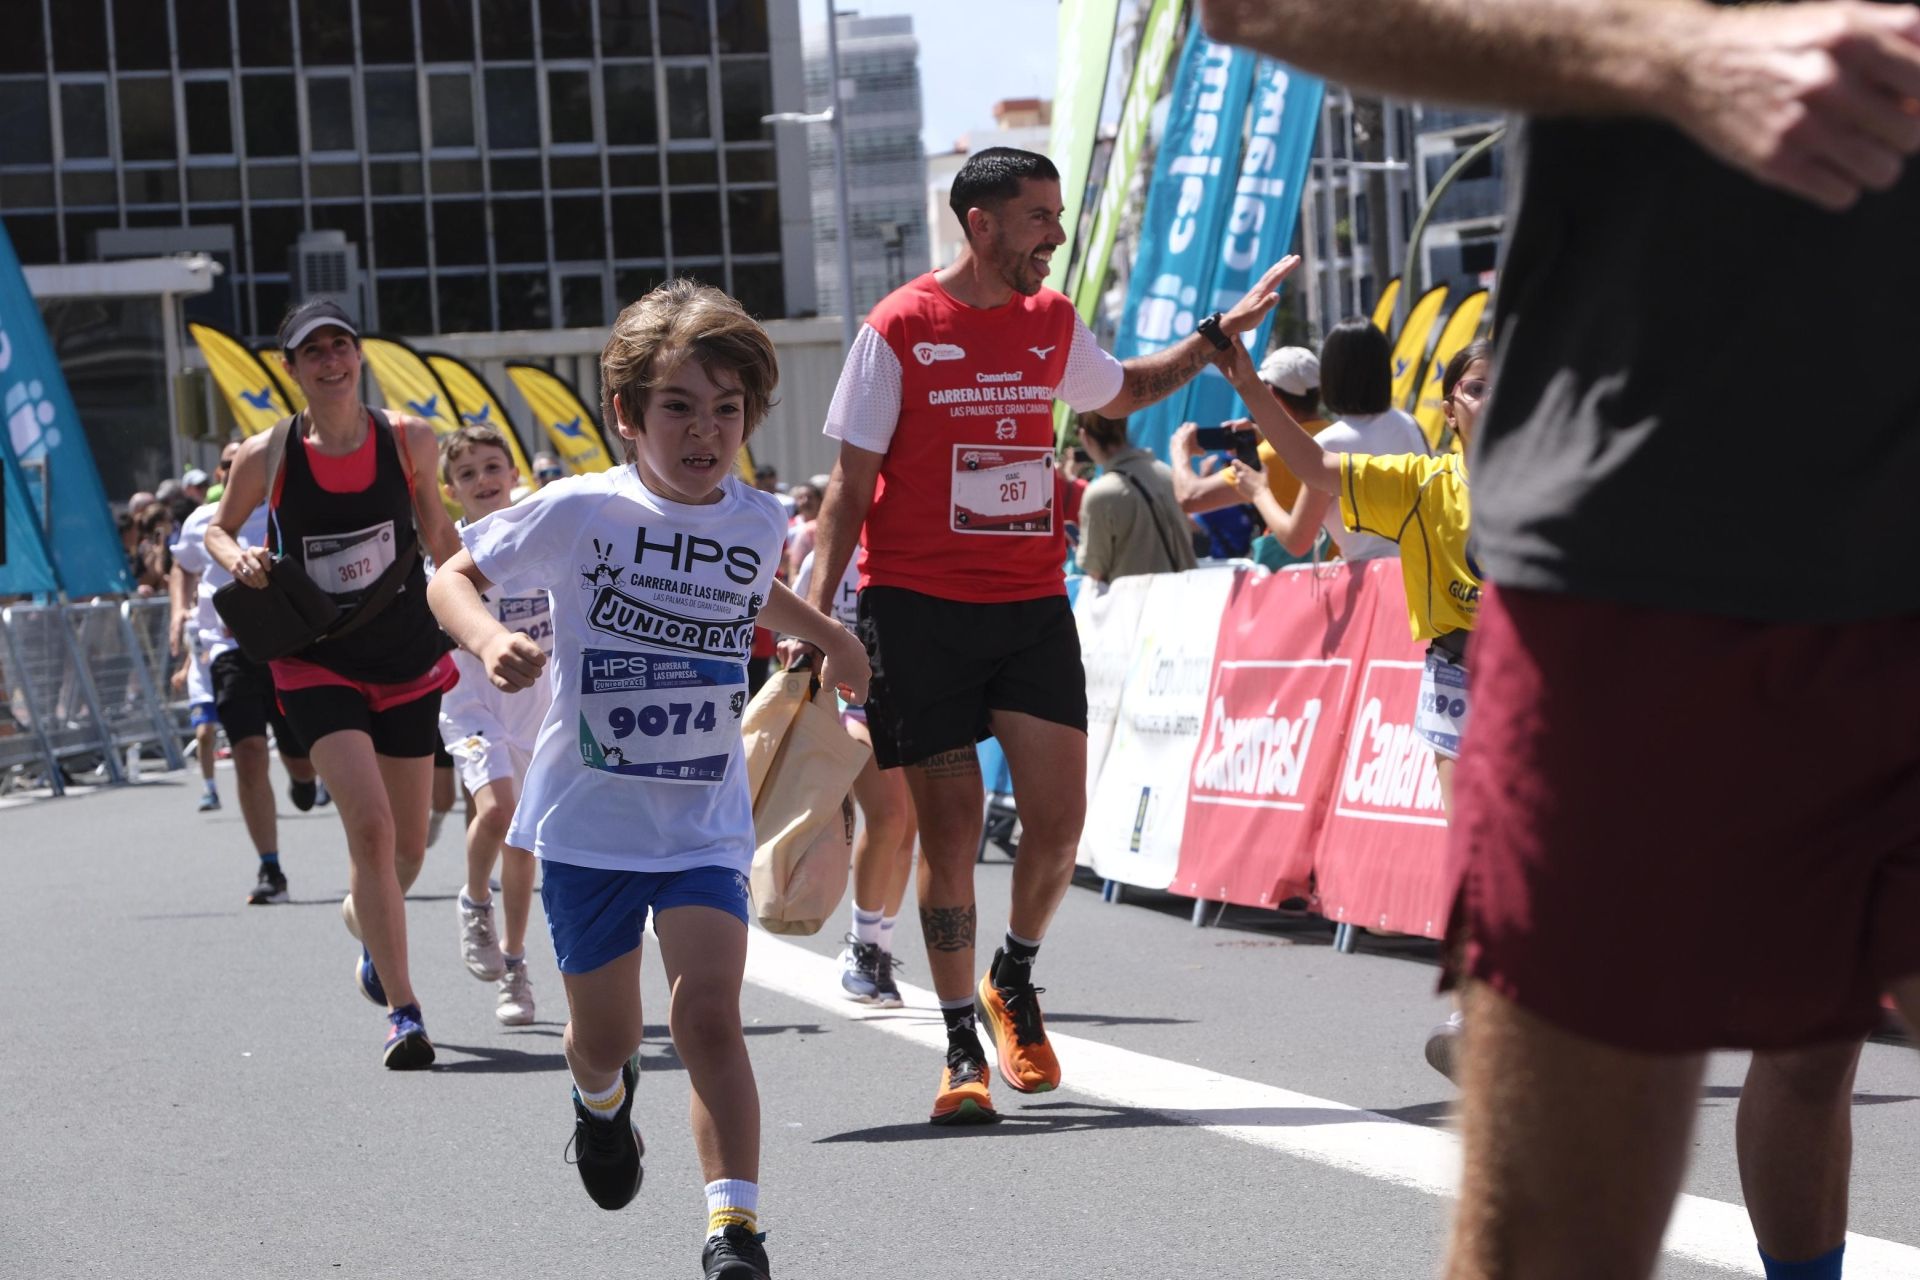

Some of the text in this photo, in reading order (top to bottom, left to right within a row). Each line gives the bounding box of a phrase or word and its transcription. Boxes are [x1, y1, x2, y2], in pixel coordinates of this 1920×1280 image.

[976, 371, 1023, 383] Canarias7
[928, 388, 982, 405] CARRERA
[982, 387, 997, 401] DE
[997, 386, 1018, 401] LAS
[950, 407, 965, 417] LAS
[965, 405, 994, 416] PALMAS
[995, 404, 1004, 415] DE
[1005, 404, 1025, 414] GRAN
[1000, 480, 1026, 502] 267
[634, 526, 761, 585] HPS
[338, 558, 372, 582] 3672
[630, 573, 748, 608] CARRERA DE LAS EMPRESAS
[653, 592, 665, 602] LAS
[665, 594, 688, 607] PALMAS
[688, 599, 696, 608] DE
[697, 600, 712, 611] GRAN
[601, 600, 698, 644] JUNIOR
[588, 657, 690, 678] HPS CARRERA DE
[653, 670, 698, 680] LAS EMPRESAS
[595, 678, 644, 690] JUNIOR RACE
[608, 701, 717, 739] 9074
